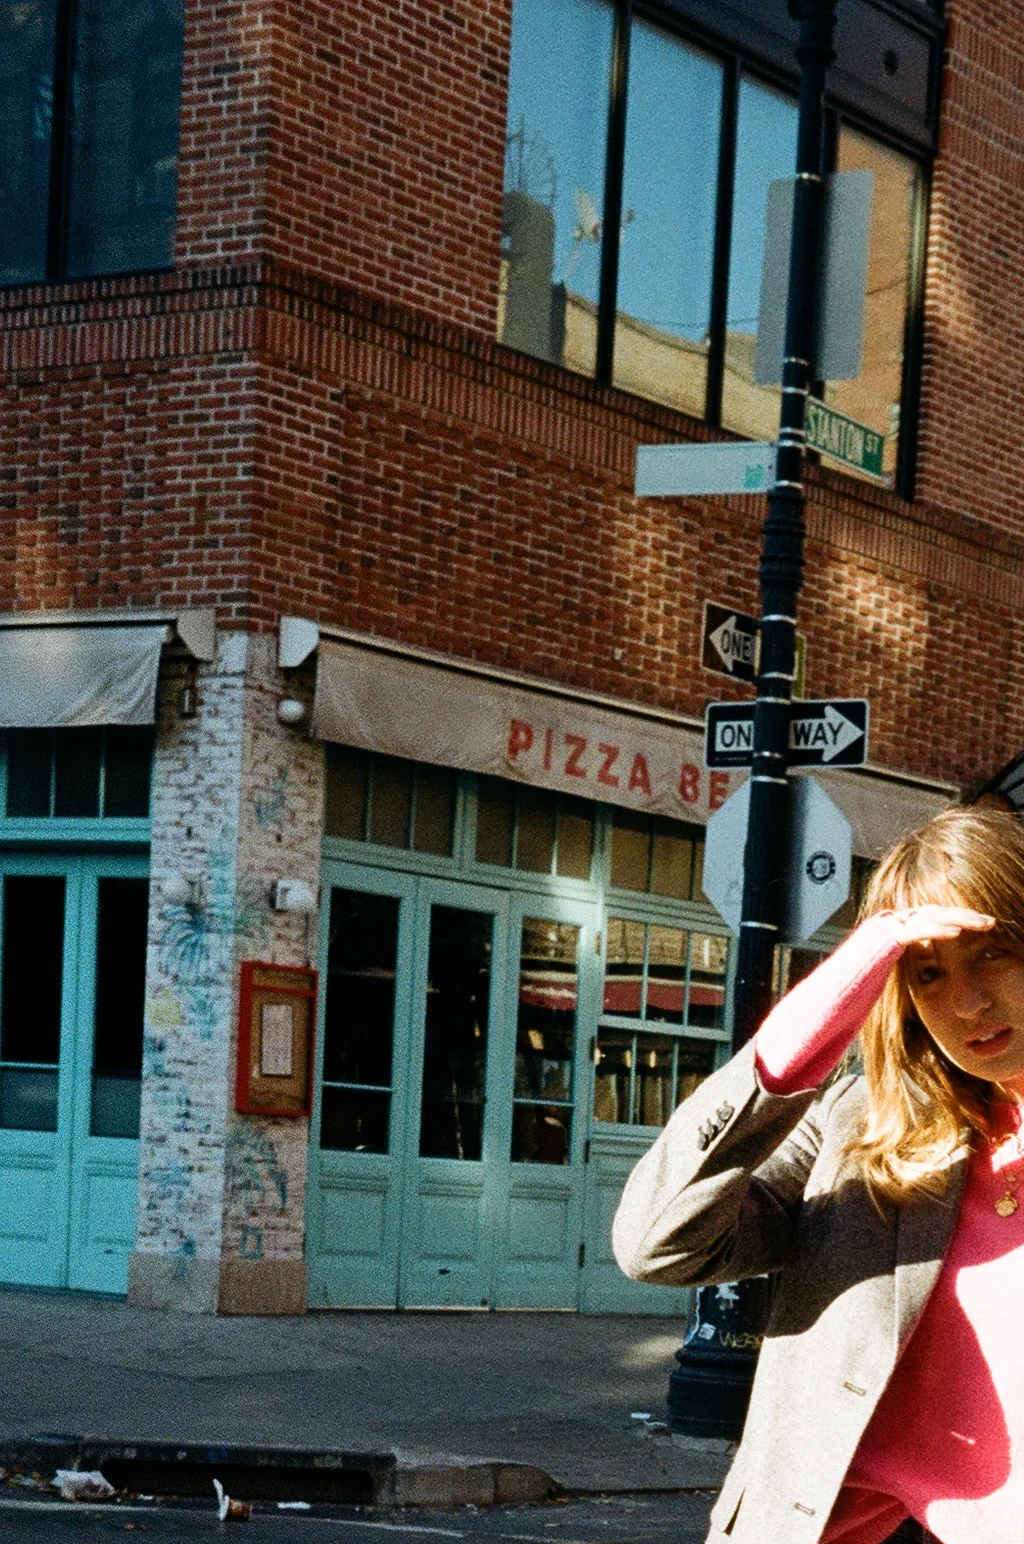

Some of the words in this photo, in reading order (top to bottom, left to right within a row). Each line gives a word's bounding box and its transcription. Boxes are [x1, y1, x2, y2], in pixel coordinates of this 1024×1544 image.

[806, 405, 864, 466] STANTON
[720, 628, 751, 661] ONE
[720, 724, 751, 748] ON
[794, 721, 844, 746] WAY
[506, 718, 652, 796] PIZZA
[679, 761, 730, 810] BE
